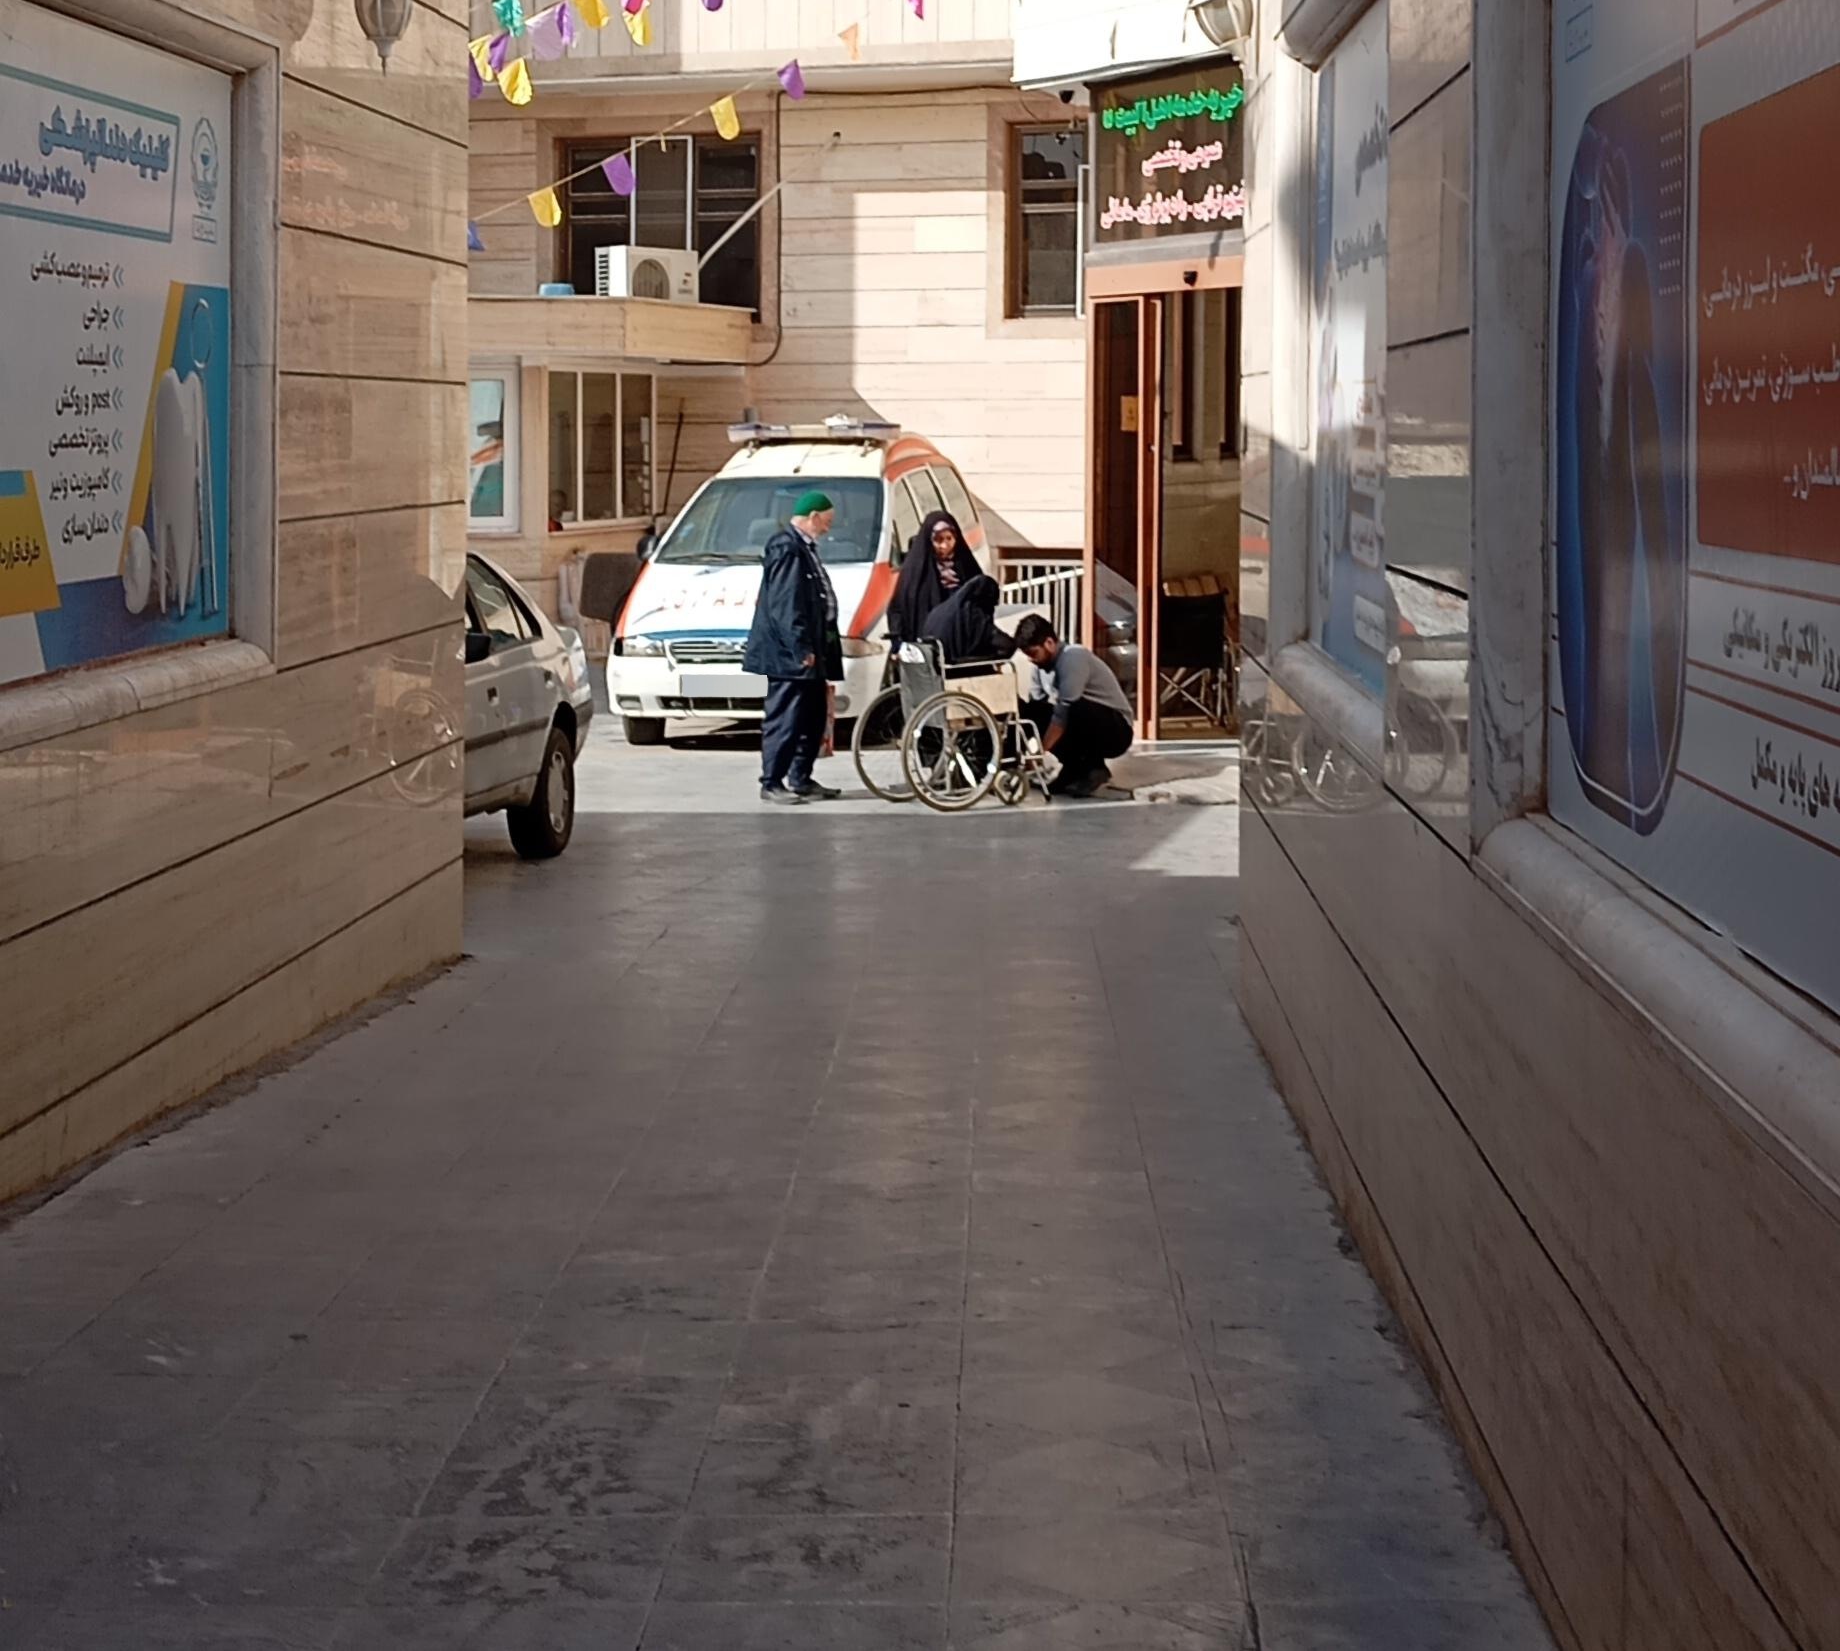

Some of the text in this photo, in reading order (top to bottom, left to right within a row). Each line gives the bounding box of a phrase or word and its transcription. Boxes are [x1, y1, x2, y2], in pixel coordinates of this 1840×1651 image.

[38, 104, 171, 182] کلینیک دندانپزشکی
[23, 163, 50, 199] خیریه
[50, 165, 86, 206] درمانگاه
[88, 261, 110, 289] ترمیم
[83, 300, 110, 331] جراحی
[76, 343, 110, 377] ایمپلنت
[55, 384, 83, 416] روکش
[49, 426, 109, 457] پروتز تخصصی
[70, 467, 110, 501] کامپوزیت
[21, 534, 40, 568] طرف
[1723, 607, 1761, 658] مکانیکی
[1751, 736, 1777, 790] مکمل
[1779, 764, 1786, 804] و
[1788, 751, 1806, 816] پایه
